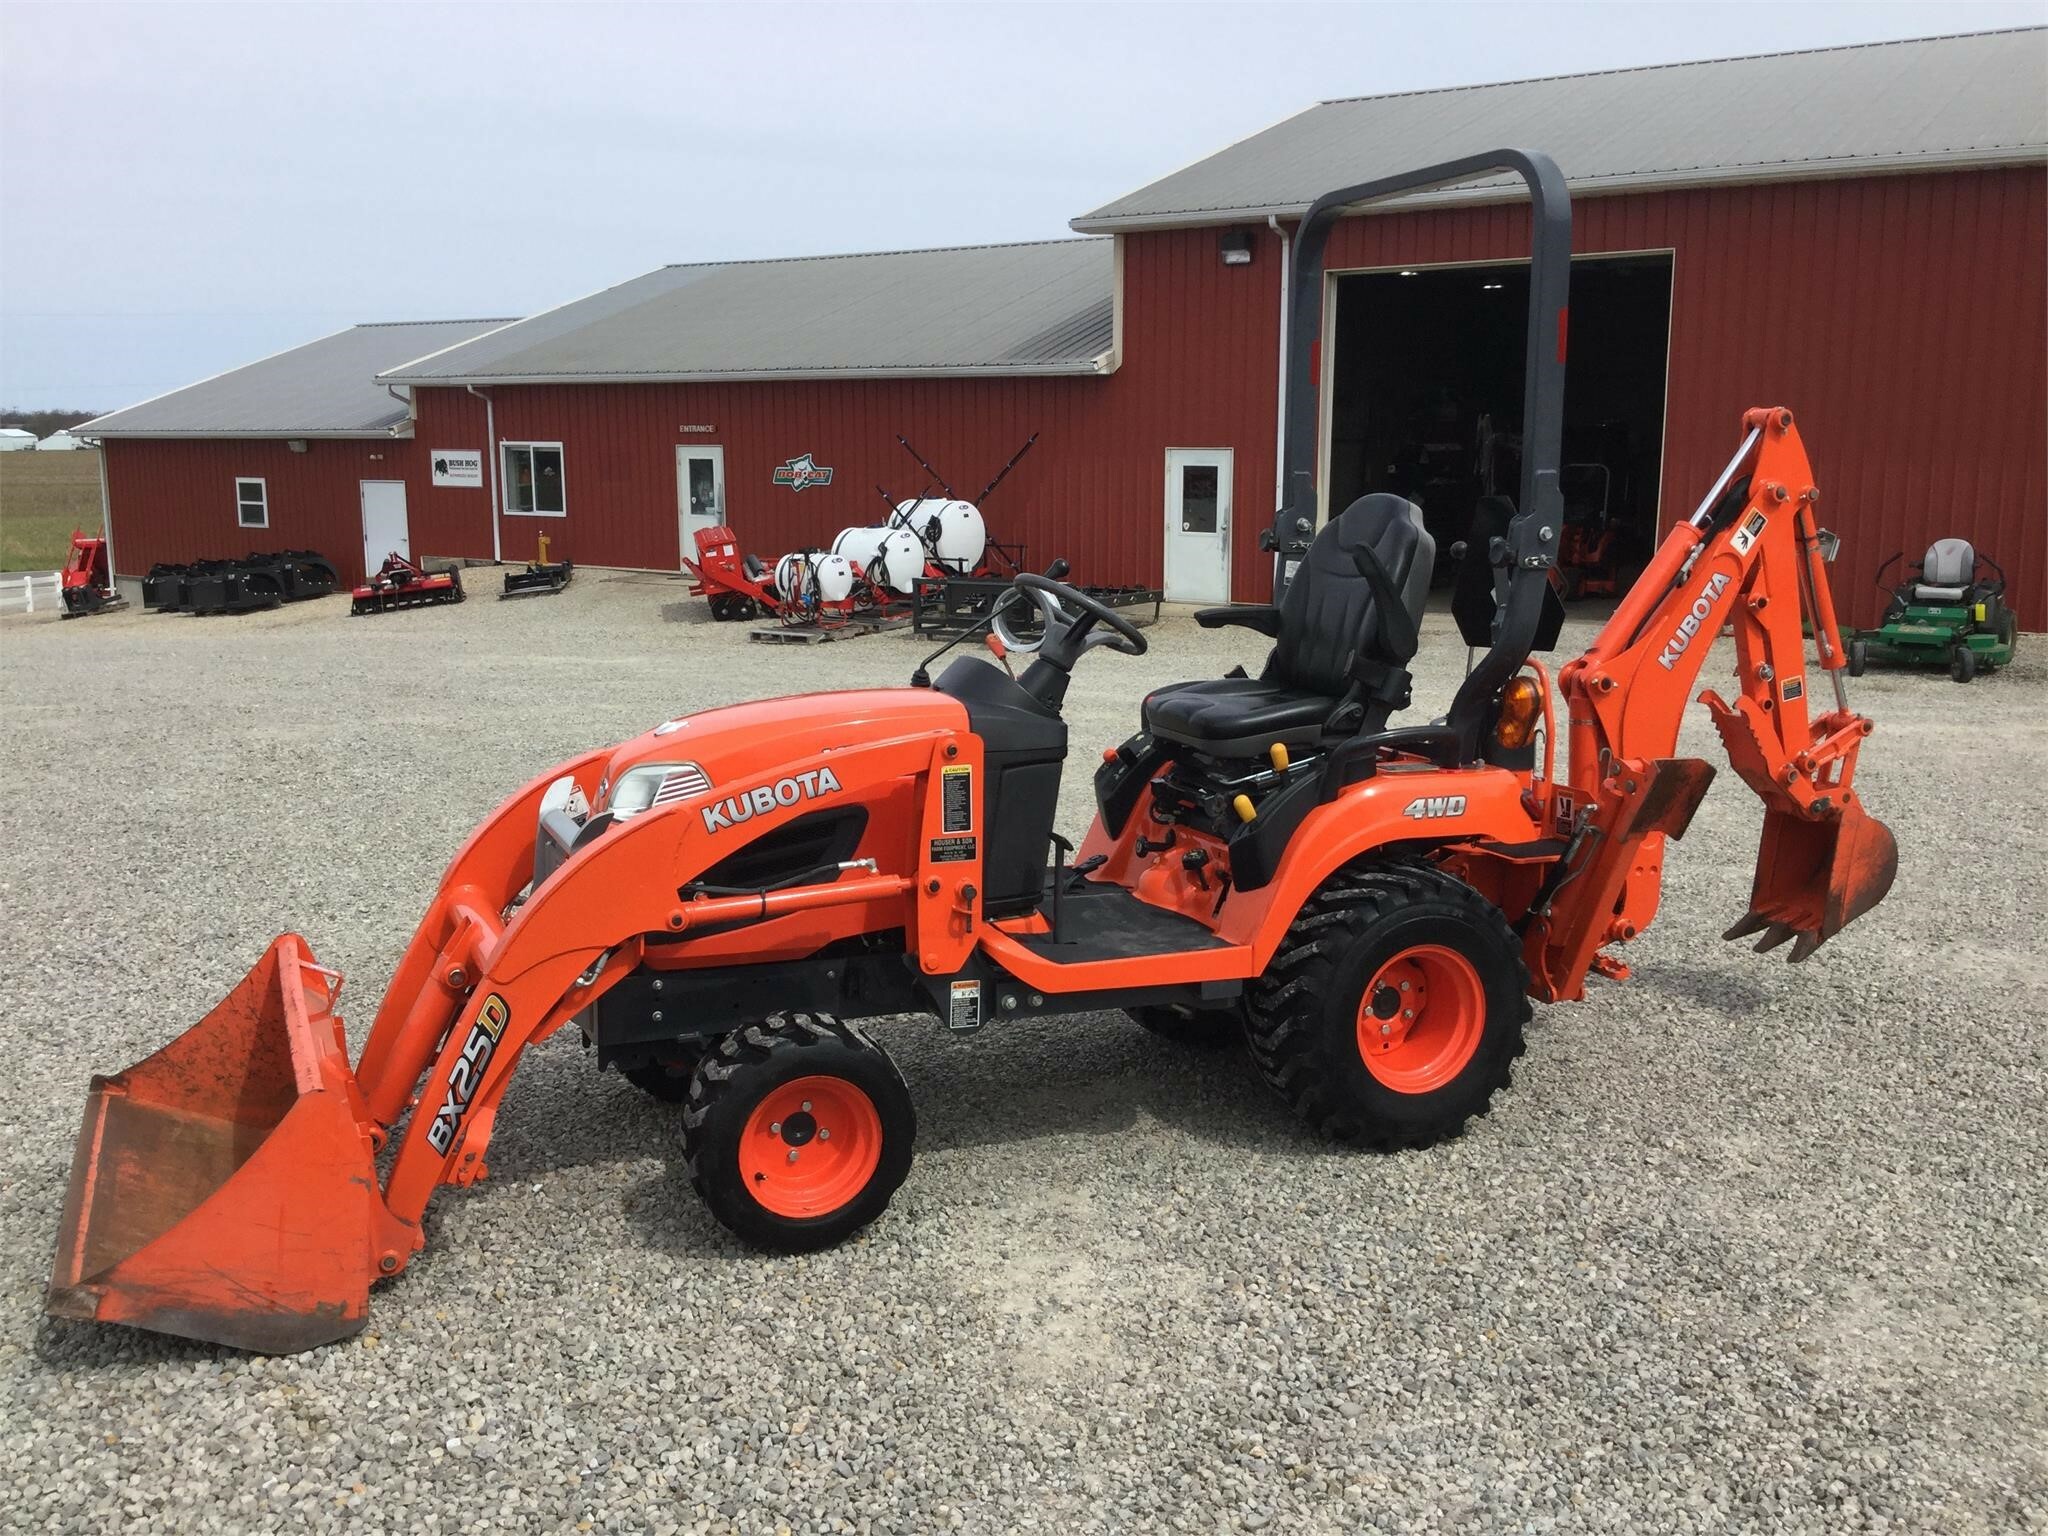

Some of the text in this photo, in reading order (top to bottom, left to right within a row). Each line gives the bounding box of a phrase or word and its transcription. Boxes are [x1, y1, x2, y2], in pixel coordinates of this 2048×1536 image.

[679, 424, 715, 433] ENTRANCE
[448, 459, 478, 467] BUSH HOG
[1657, 571, 1732, 672] KUBOTA
[701, 766, 842, 835] KUBOTA
[1402, 795, 1467, 820] 4WD
[426, 992, 511, 1158] BX25D
